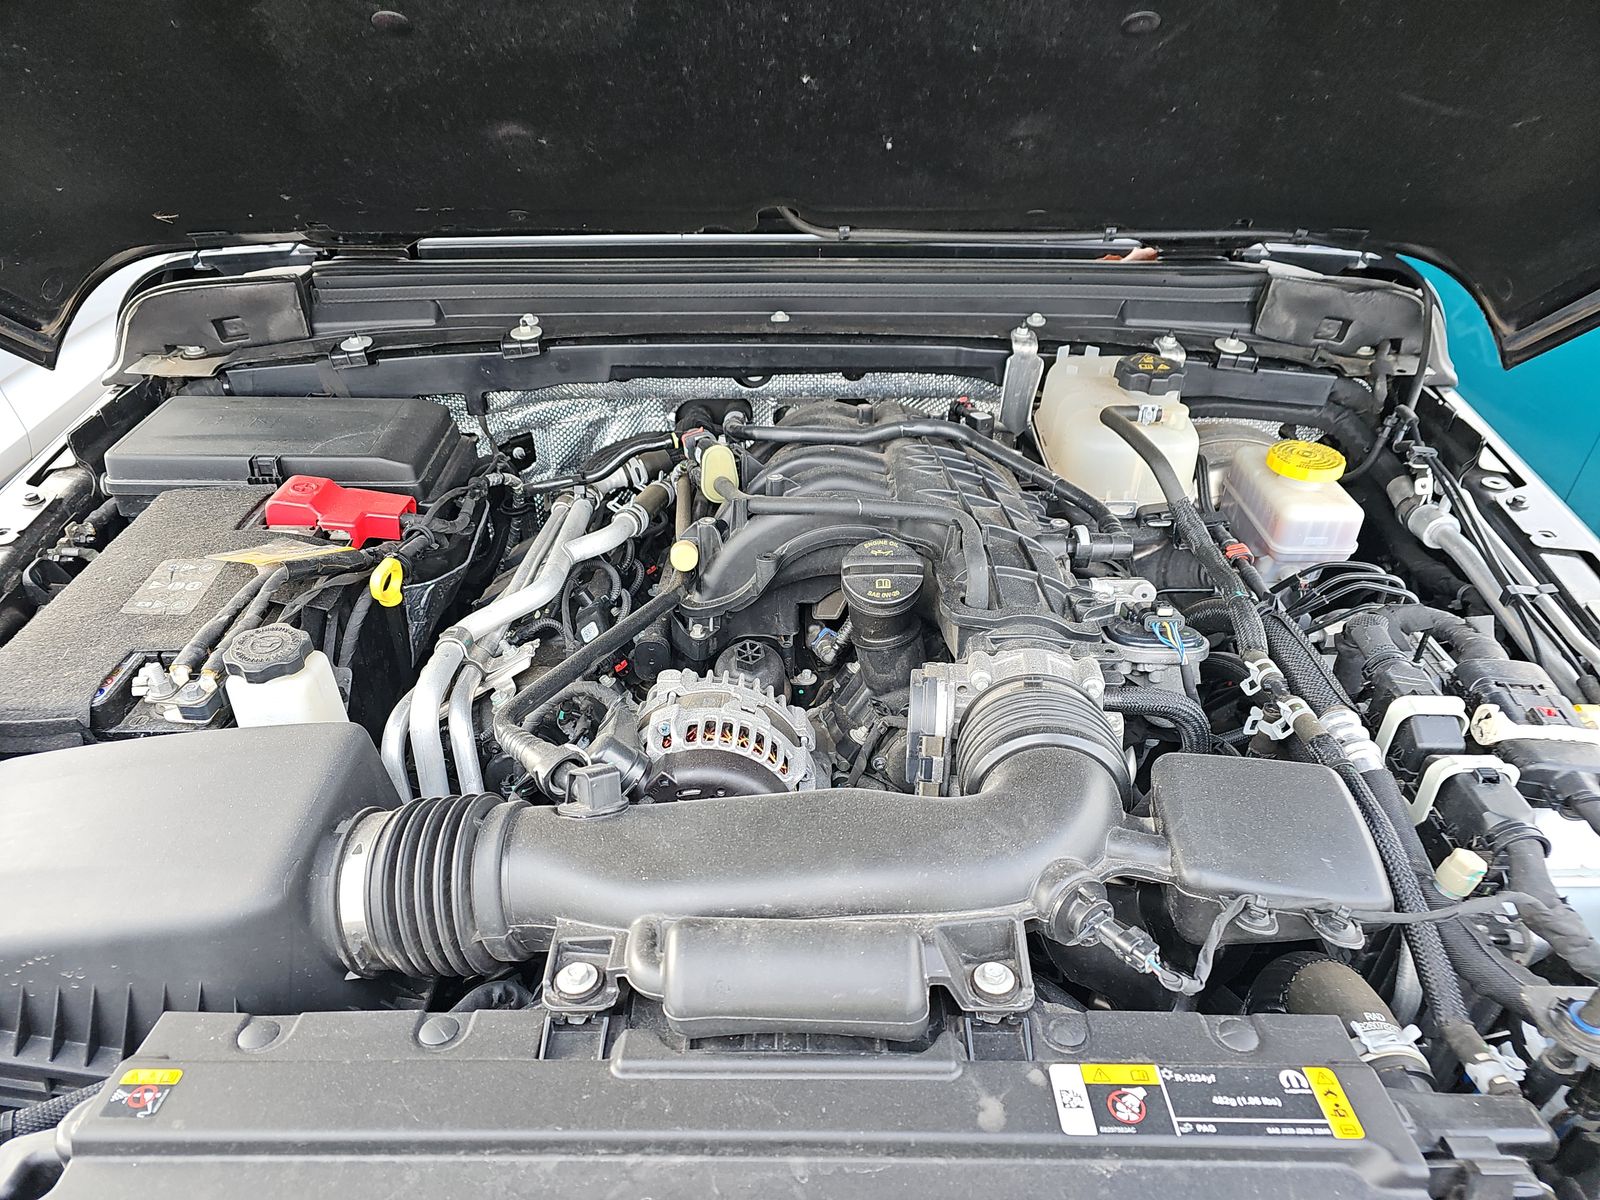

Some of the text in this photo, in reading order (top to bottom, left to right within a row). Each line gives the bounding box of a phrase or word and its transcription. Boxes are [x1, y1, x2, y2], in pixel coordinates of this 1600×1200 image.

[864, 540, 888, 549] ENGINE
[867, 590, 881, 598] SAE
[1363, 1012, 1386, 1021] RAD
